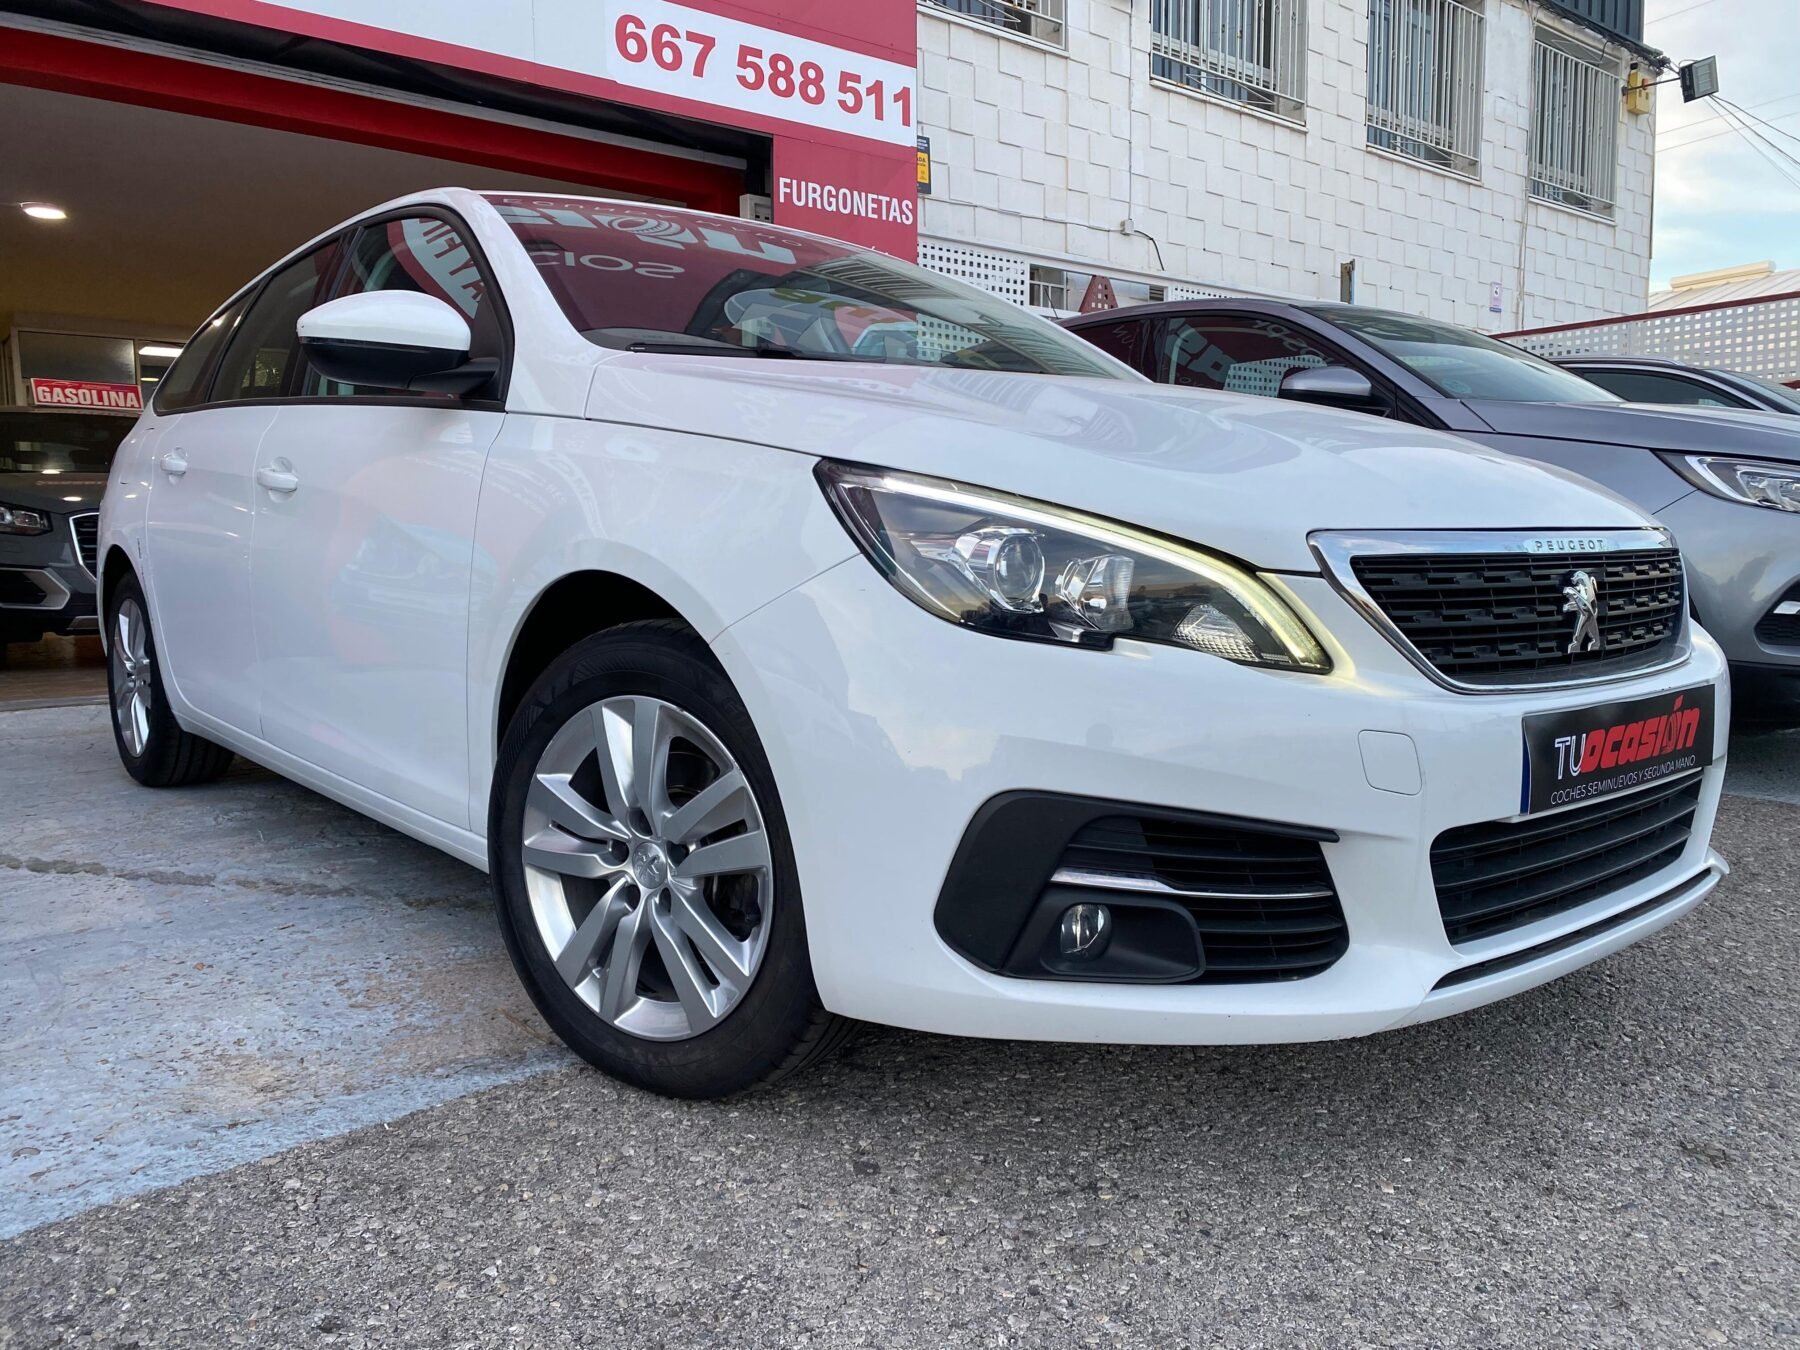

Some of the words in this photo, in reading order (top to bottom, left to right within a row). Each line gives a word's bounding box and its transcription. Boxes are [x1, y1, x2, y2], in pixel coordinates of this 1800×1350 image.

[615, 14, 716, 78] 667
[736, 44, 825, 105] 588
[837, 70, 911, 127] 511
[779, 177, 913, 225] FURGONETAS
[36, 386, 140, 407] GASOLINA
[1534, 540, 1604, 551] PEUGEOT
[1550, 784, 1587, 805] COCHES
[1588, 771, 1638, 796] SEMINUEVOS
[1644, 762, 1675, 780] SEGUNDA
[1675, 755, 1696, 769] MANO
